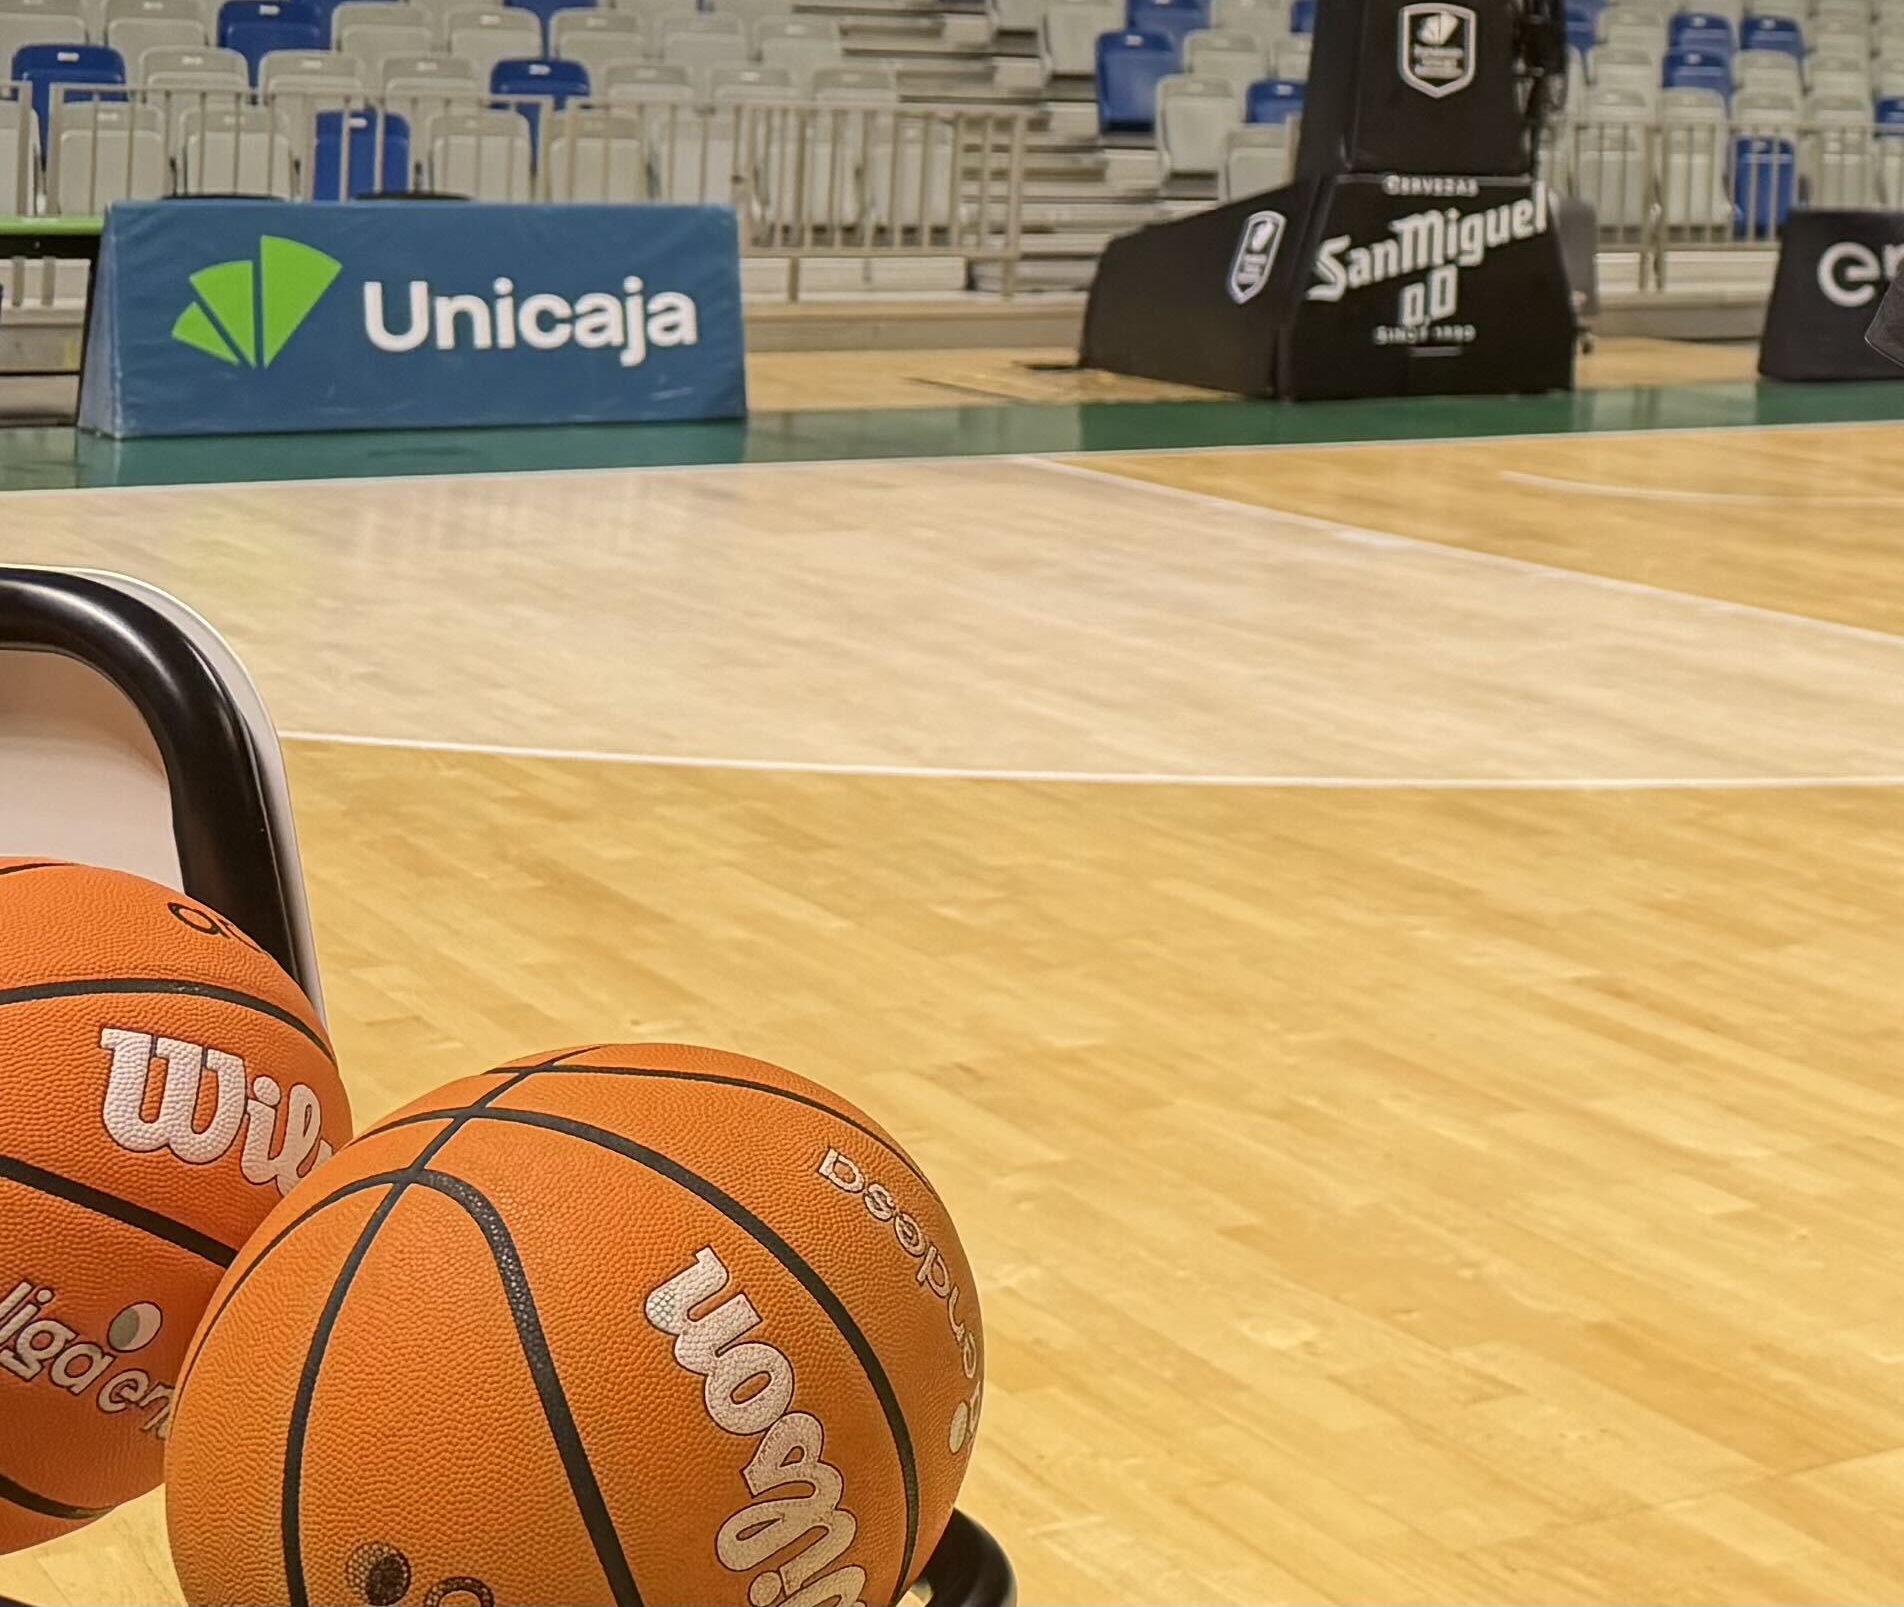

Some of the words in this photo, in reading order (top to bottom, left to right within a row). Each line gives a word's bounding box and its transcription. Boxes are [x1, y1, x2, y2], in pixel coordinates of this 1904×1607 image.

[363, 275, 698, 367] Unicaja
[99, 1027, 333, 1198] Wil
[818, 1146, 978, 1380] endesa
